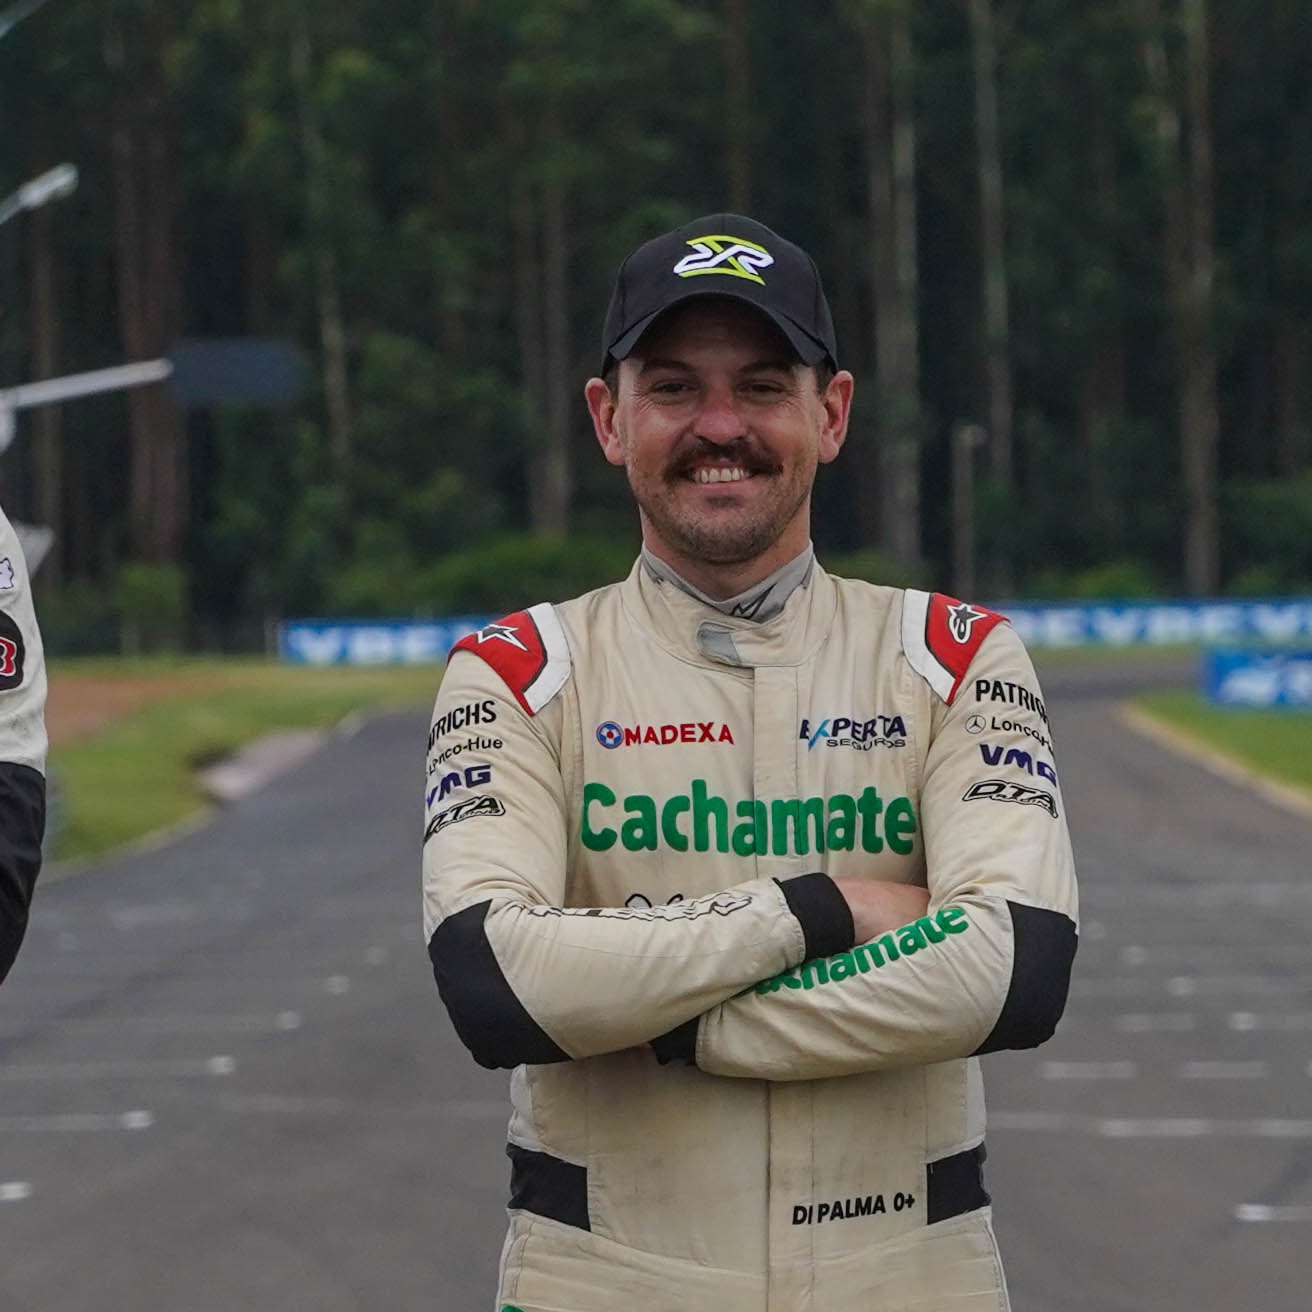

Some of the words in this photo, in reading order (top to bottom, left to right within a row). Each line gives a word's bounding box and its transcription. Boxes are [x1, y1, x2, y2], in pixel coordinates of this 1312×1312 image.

[426, 700, 497, 757] TRICHS
[624, 721, 734, 747] MADEXA
[826, 736, 907, 751] SEGUROS
[581, 779, 917, 856] Cachamate
[756, 907, 970, 995] chamate
[792, 1205, 814, 1225] DI
[817, 1195, 887, 1223] PALMA
